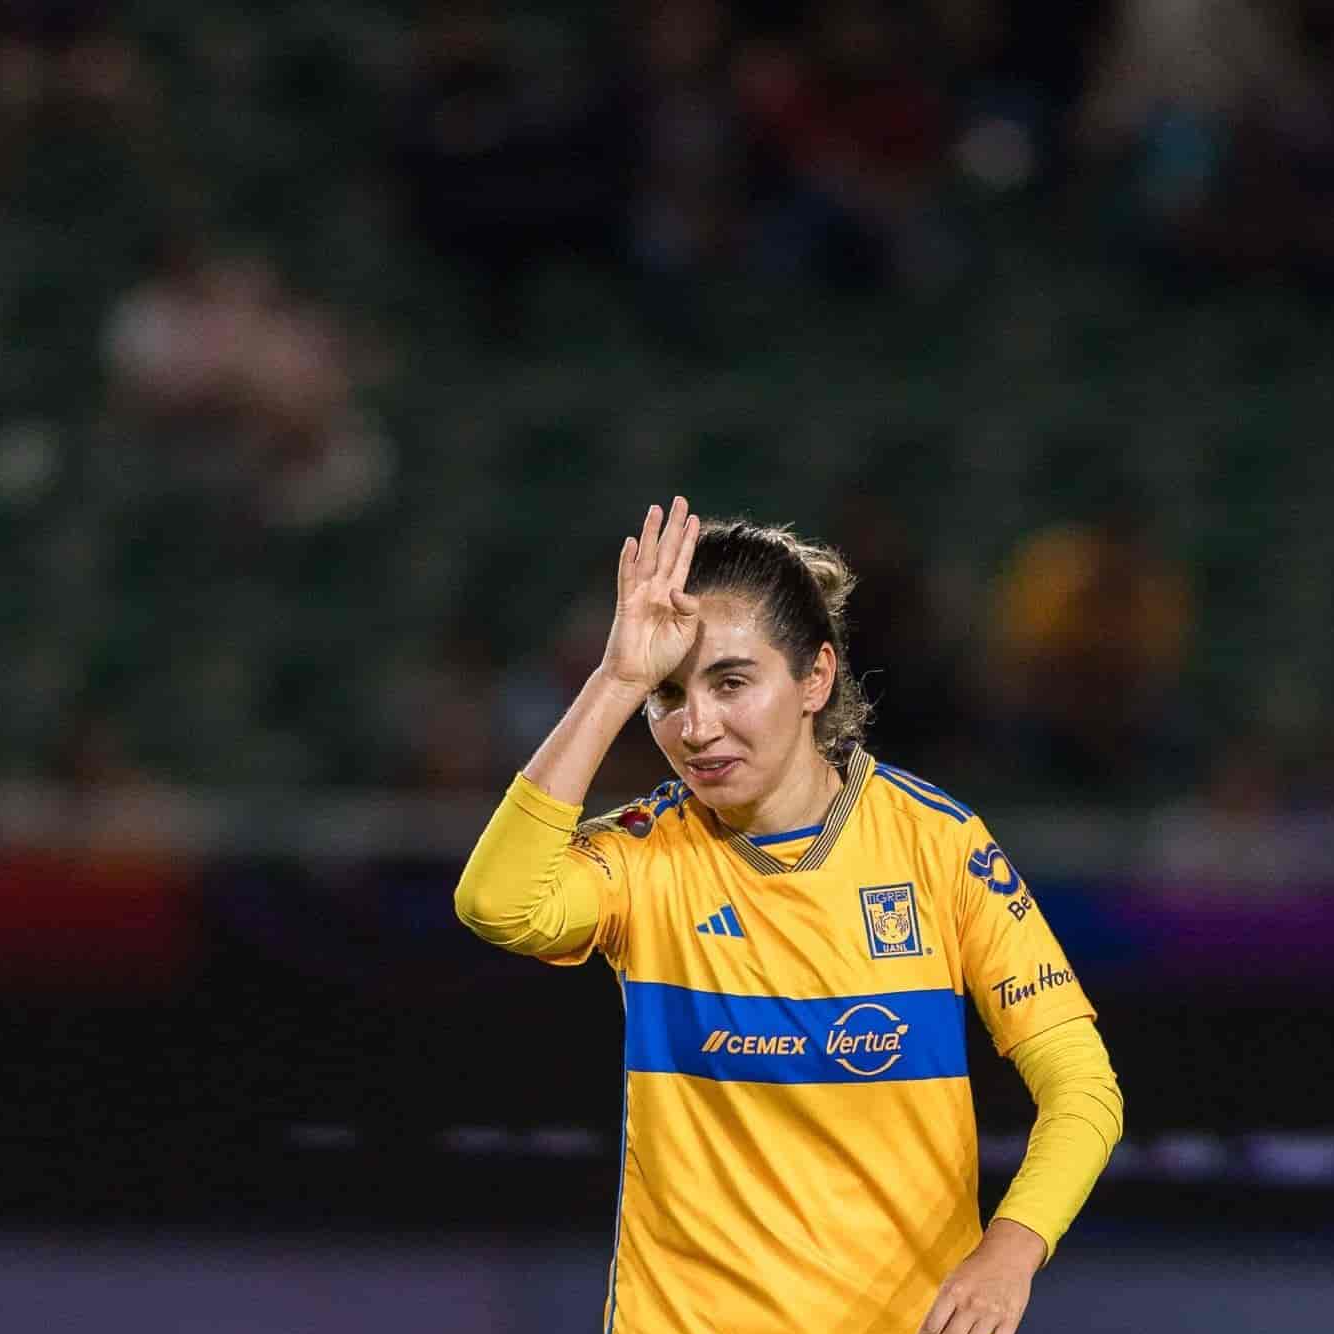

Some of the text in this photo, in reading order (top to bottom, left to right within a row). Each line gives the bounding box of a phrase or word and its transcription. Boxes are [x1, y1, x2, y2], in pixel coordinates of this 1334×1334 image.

[1007, 891, 1033, 922] Be
[991, 963, 1076, 1009] Tim Hor
[726, 1035, 808, 1056] CEMEX
